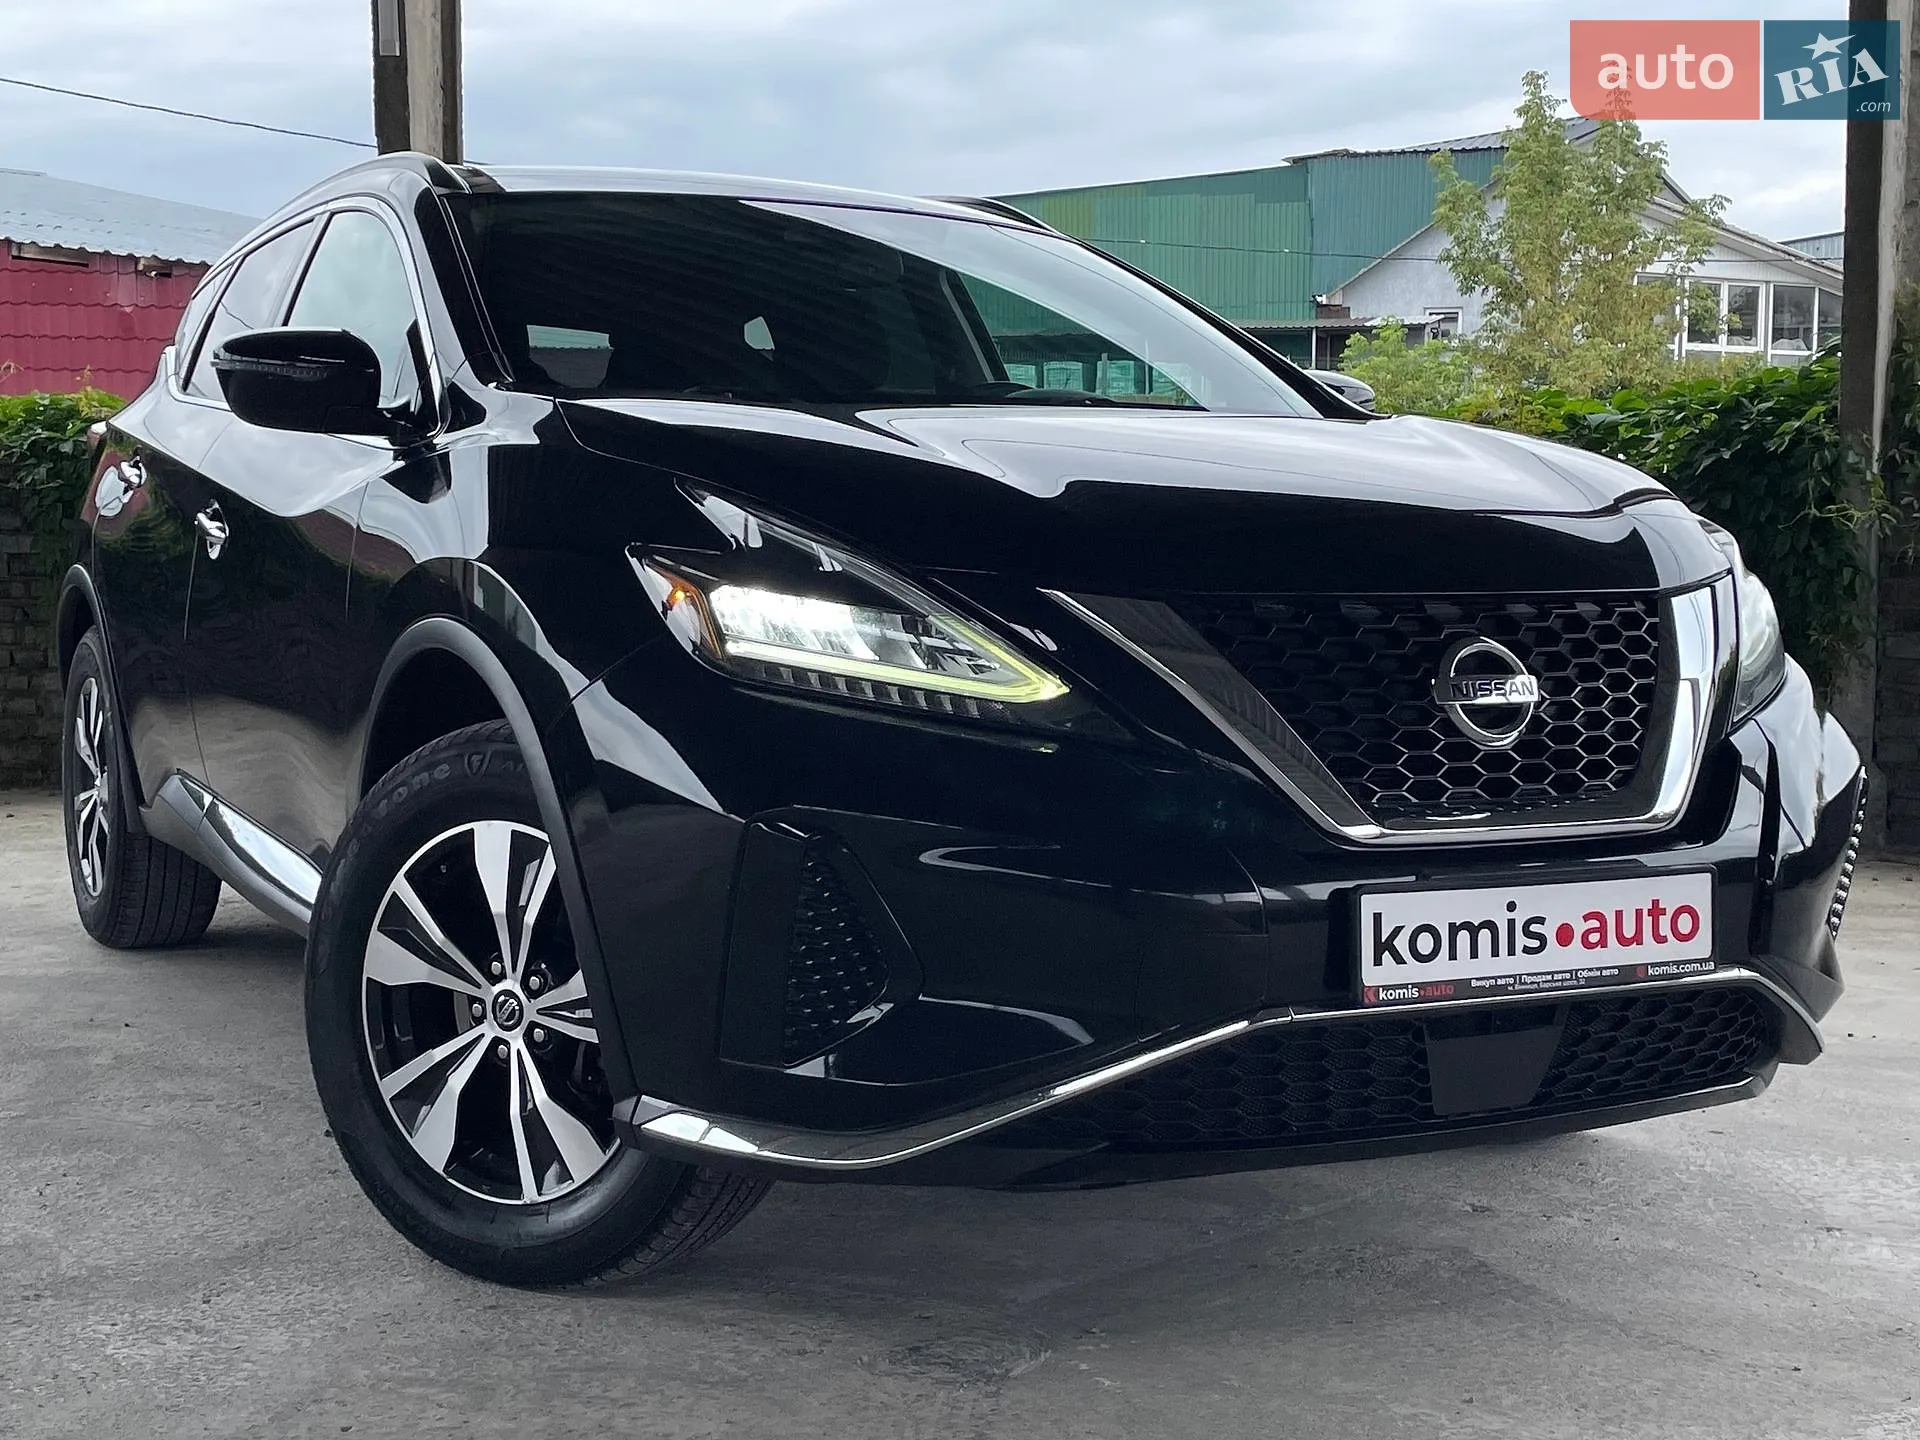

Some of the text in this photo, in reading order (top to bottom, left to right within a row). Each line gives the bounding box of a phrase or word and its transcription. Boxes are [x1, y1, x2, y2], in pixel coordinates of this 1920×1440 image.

[1450, 680, 1534, 697] NISSAN
[1496, 977, 1515, 985] авто
[1553, 972, 1571, 980] авто
[1601, 968, 1619, 976] авто
[1647, 961, 1715, 976] komis.com.ua
